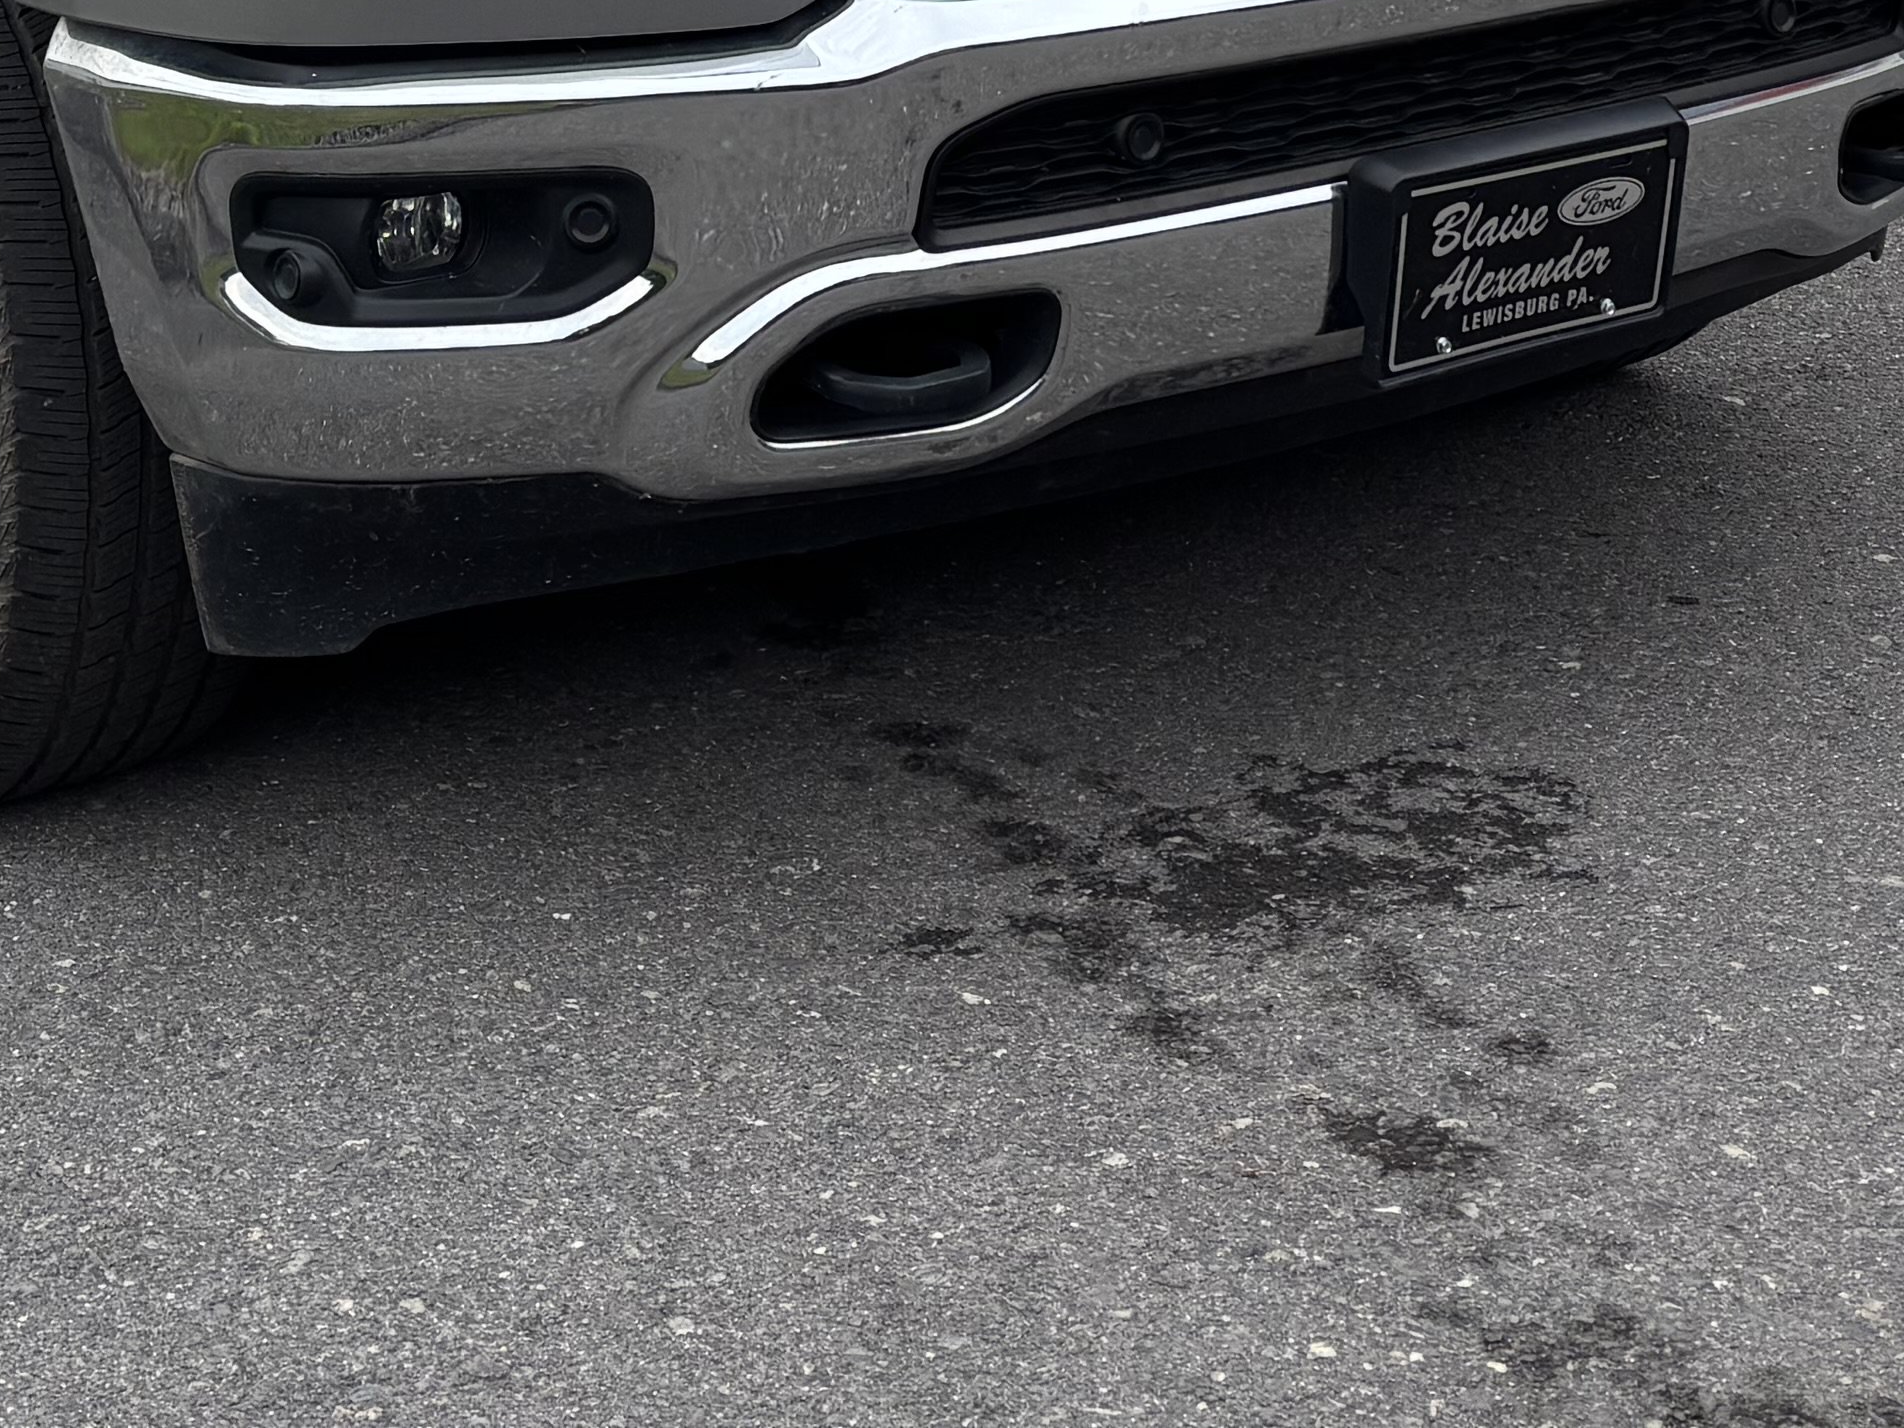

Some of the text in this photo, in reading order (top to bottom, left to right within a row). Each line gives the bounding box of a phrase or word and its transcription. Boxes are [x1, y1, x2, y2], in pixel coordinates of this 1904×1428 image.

[1573, 184, 1629, 219] Ford
[1432, 201, 1548, 257] Blaise
[1421, 236, 1611, 320] Alexander
[1461, 293, 1560, 333] LEWISBURG
